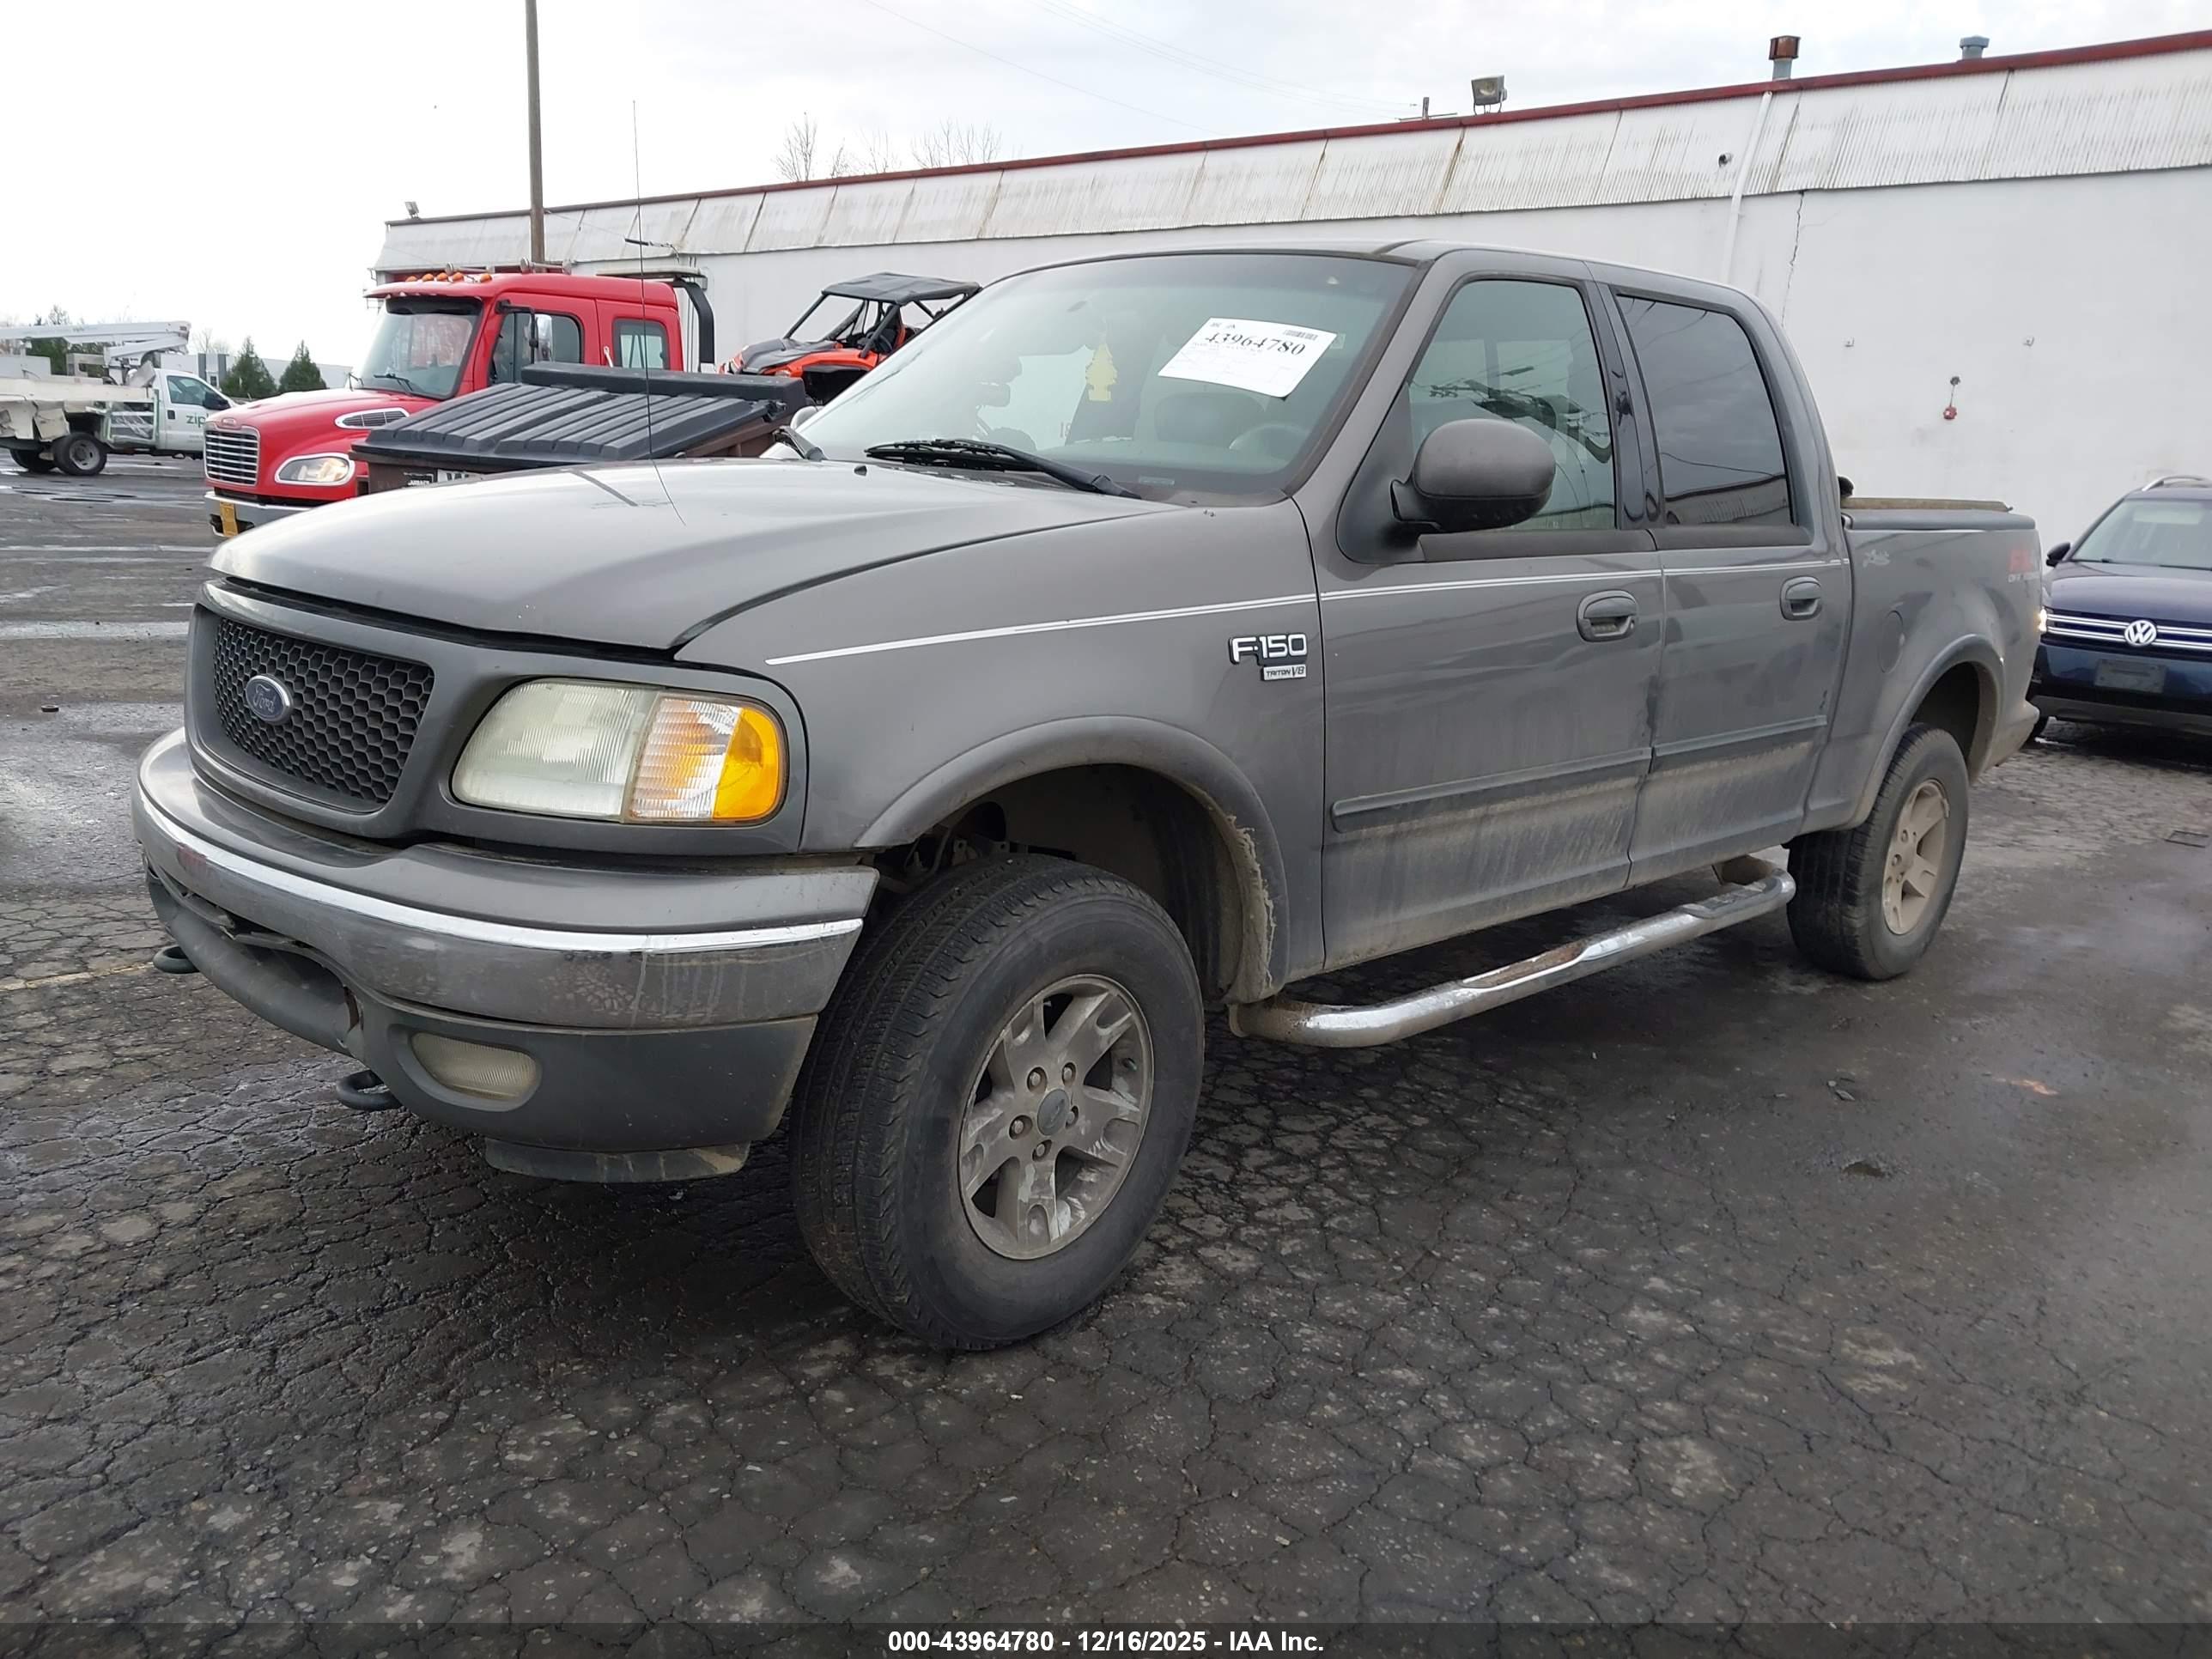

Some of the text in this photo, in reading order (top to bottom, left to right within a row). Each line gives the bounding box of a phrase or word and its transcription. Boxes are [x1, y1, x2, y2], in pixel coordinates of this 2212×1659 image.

[1205, 331, 1306, 356] 43964780
[185, 412, 210, 428] zip
[1266, 666, 1305, 678] TRITON V8
[252, 684, 276, 714] Ford
